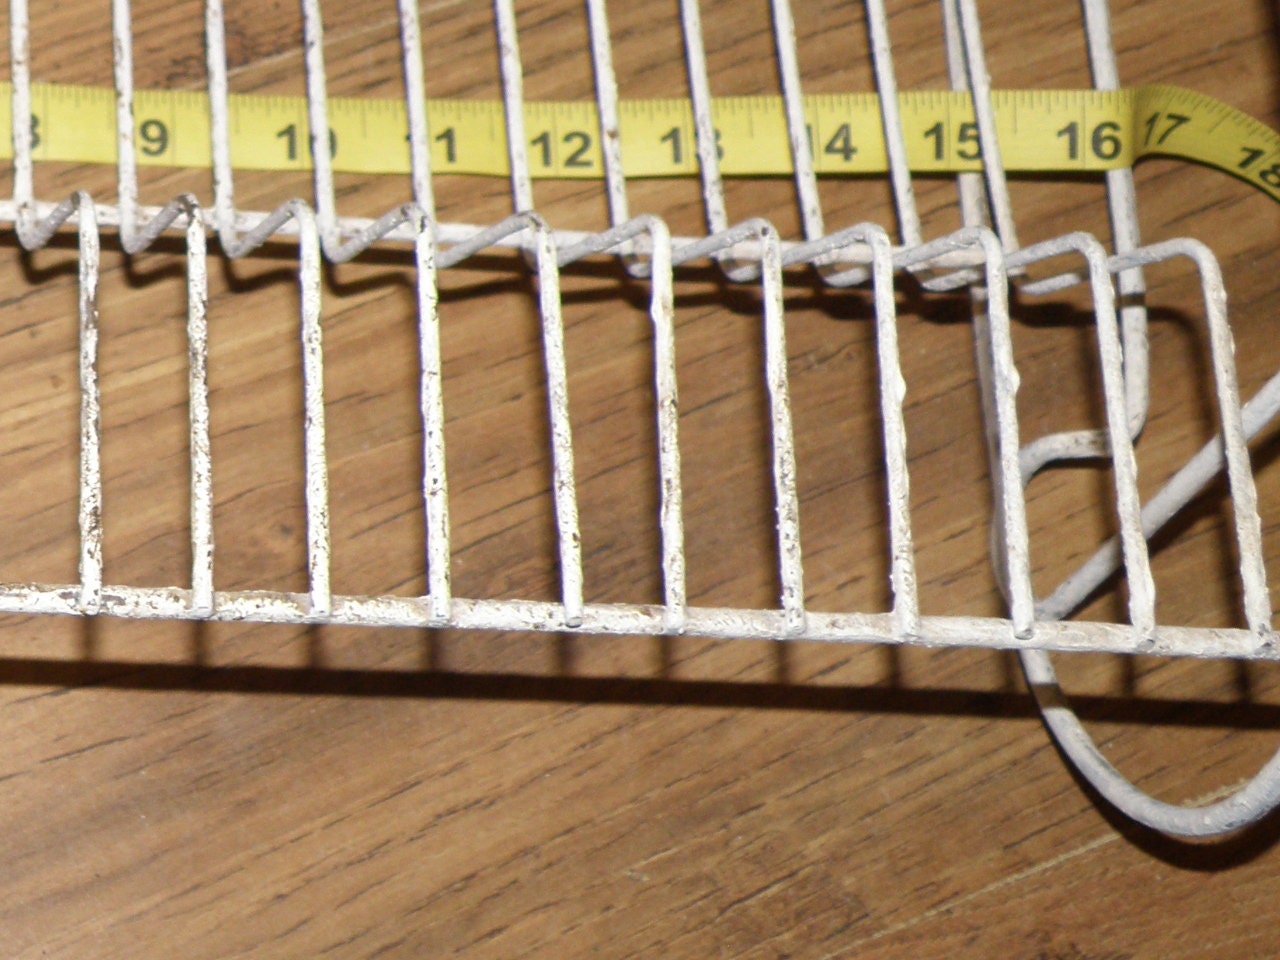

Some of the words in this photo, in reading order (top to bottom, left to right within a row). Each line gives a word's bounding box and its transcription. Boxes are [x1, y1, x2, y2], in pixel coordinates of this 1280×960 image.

[139, 118, 169, 157] 9
[923, 121, 982, 161] 15
[1056, 121, 1123, 161] 16
[1144, 111, 1192, 147] 17
[530, 131, 594, 168] 12
